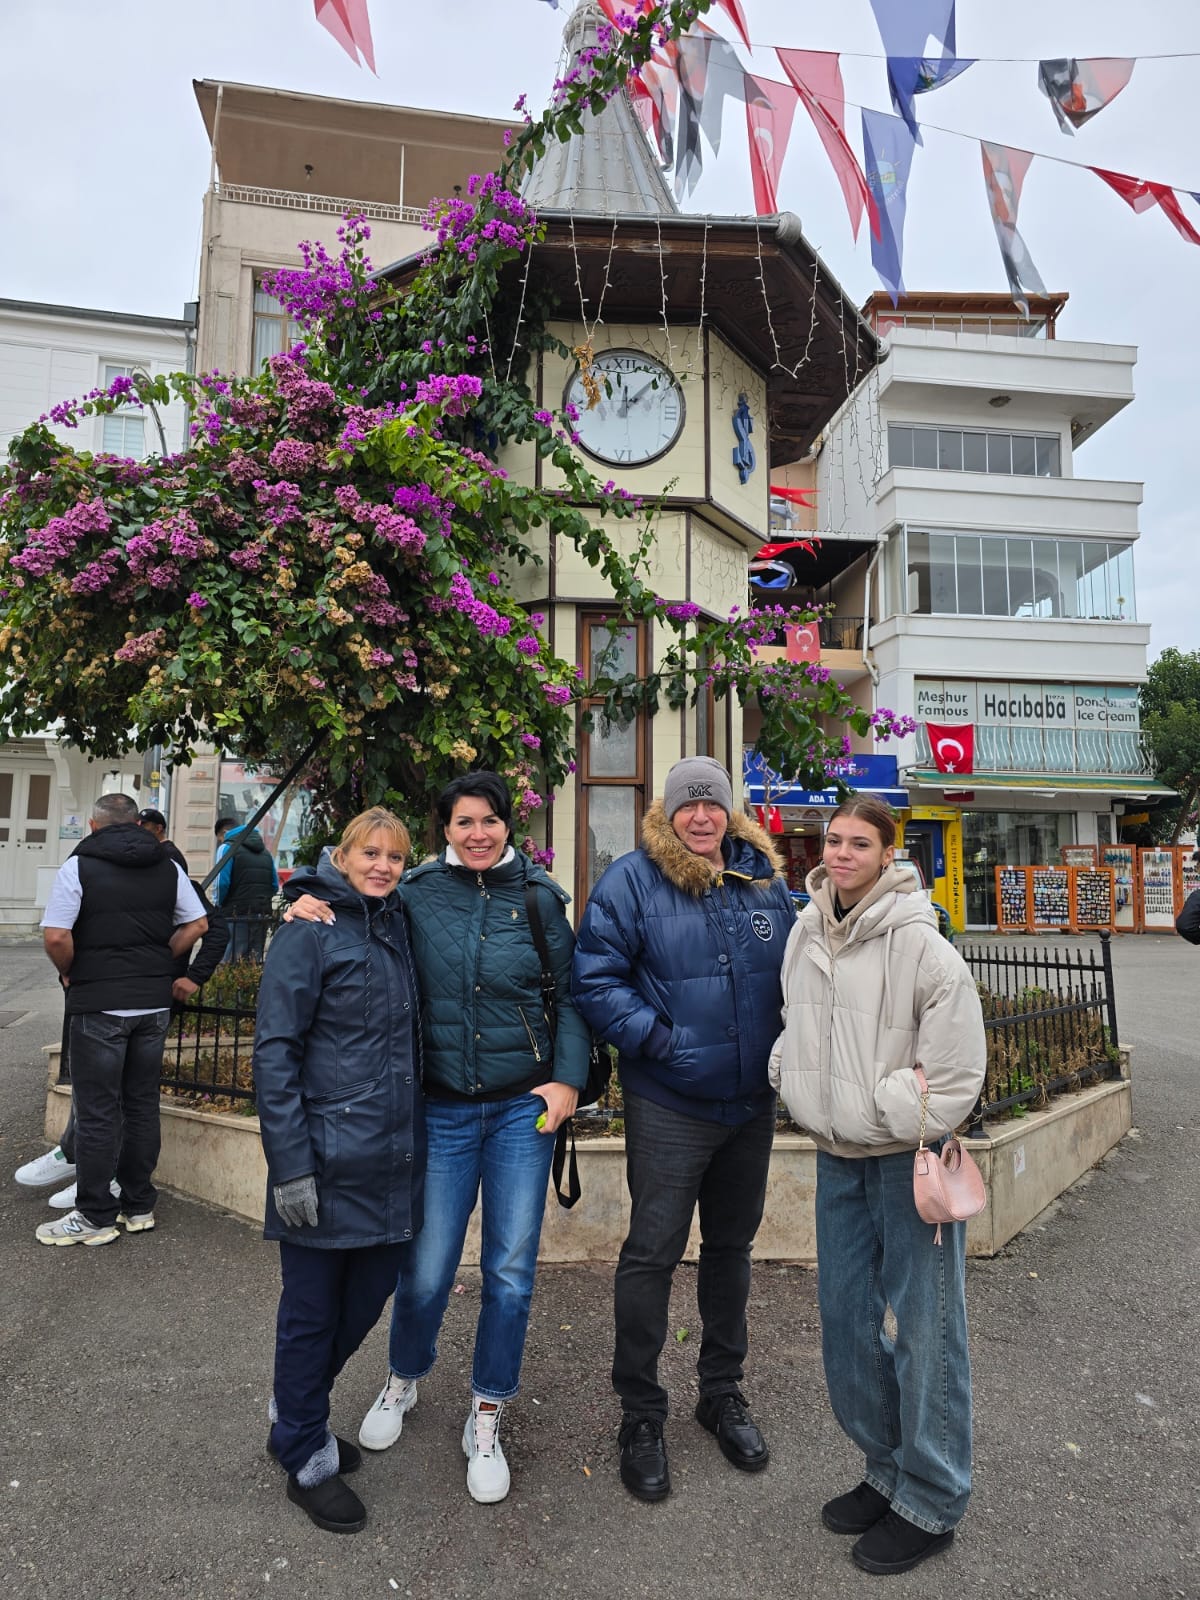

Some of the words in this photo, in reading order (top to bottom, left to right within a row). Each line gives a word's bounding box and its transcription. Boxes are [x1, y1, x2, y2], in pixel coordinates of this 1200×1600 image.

[918, 691, 967, 705] Meşhur
[918, 705, 969, 716] Famous
[984, 693, 1066, 719] Hacıbaba
[1078, 710, 1094, 721] Ice
[1098, 710, 1136, 722] Cream
[687, 784, 712, 798] MK
[809, 795, 825, 803] ADA
